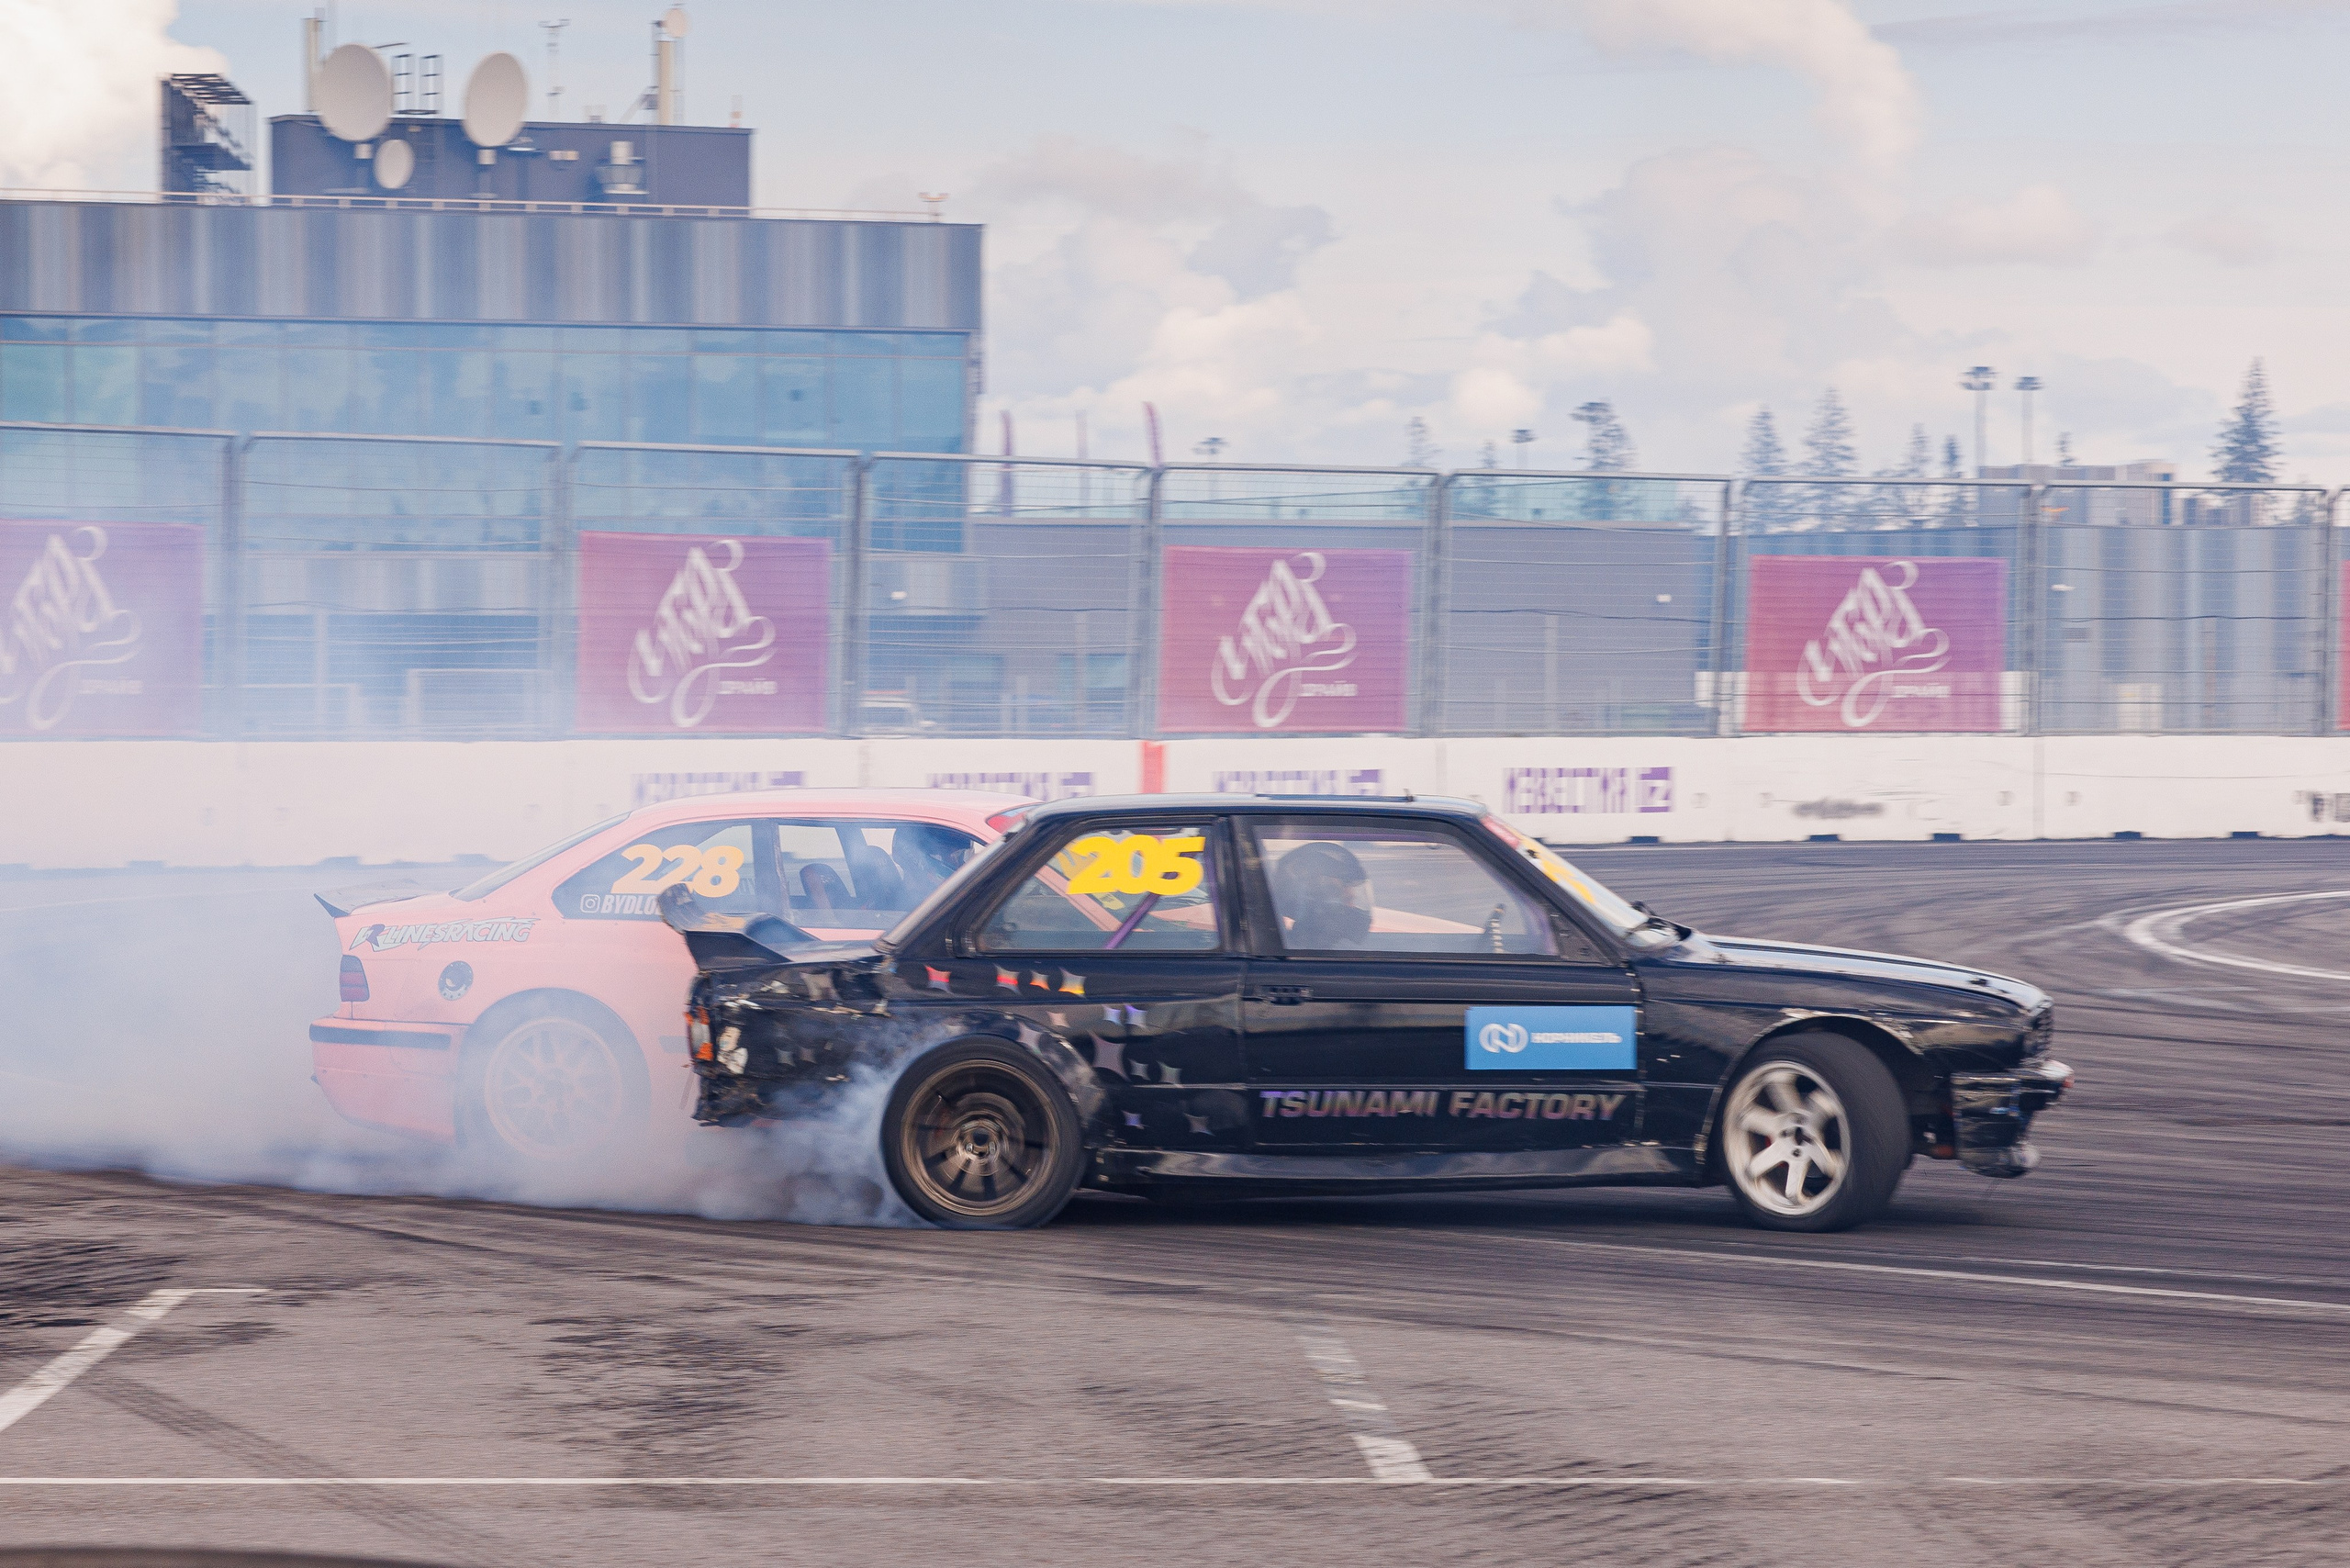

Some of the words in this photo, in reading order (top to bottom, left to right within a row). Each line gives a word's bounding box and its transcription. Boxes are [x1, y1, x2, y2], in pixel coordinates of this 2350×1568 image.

[610, 844, 744, 898] 228
[1067, 834, 1206, 895] 205
[1259, 1090, 1439, 1117] TSUNAMI
[1448, 1091, 1626, 1121] FACTORY
